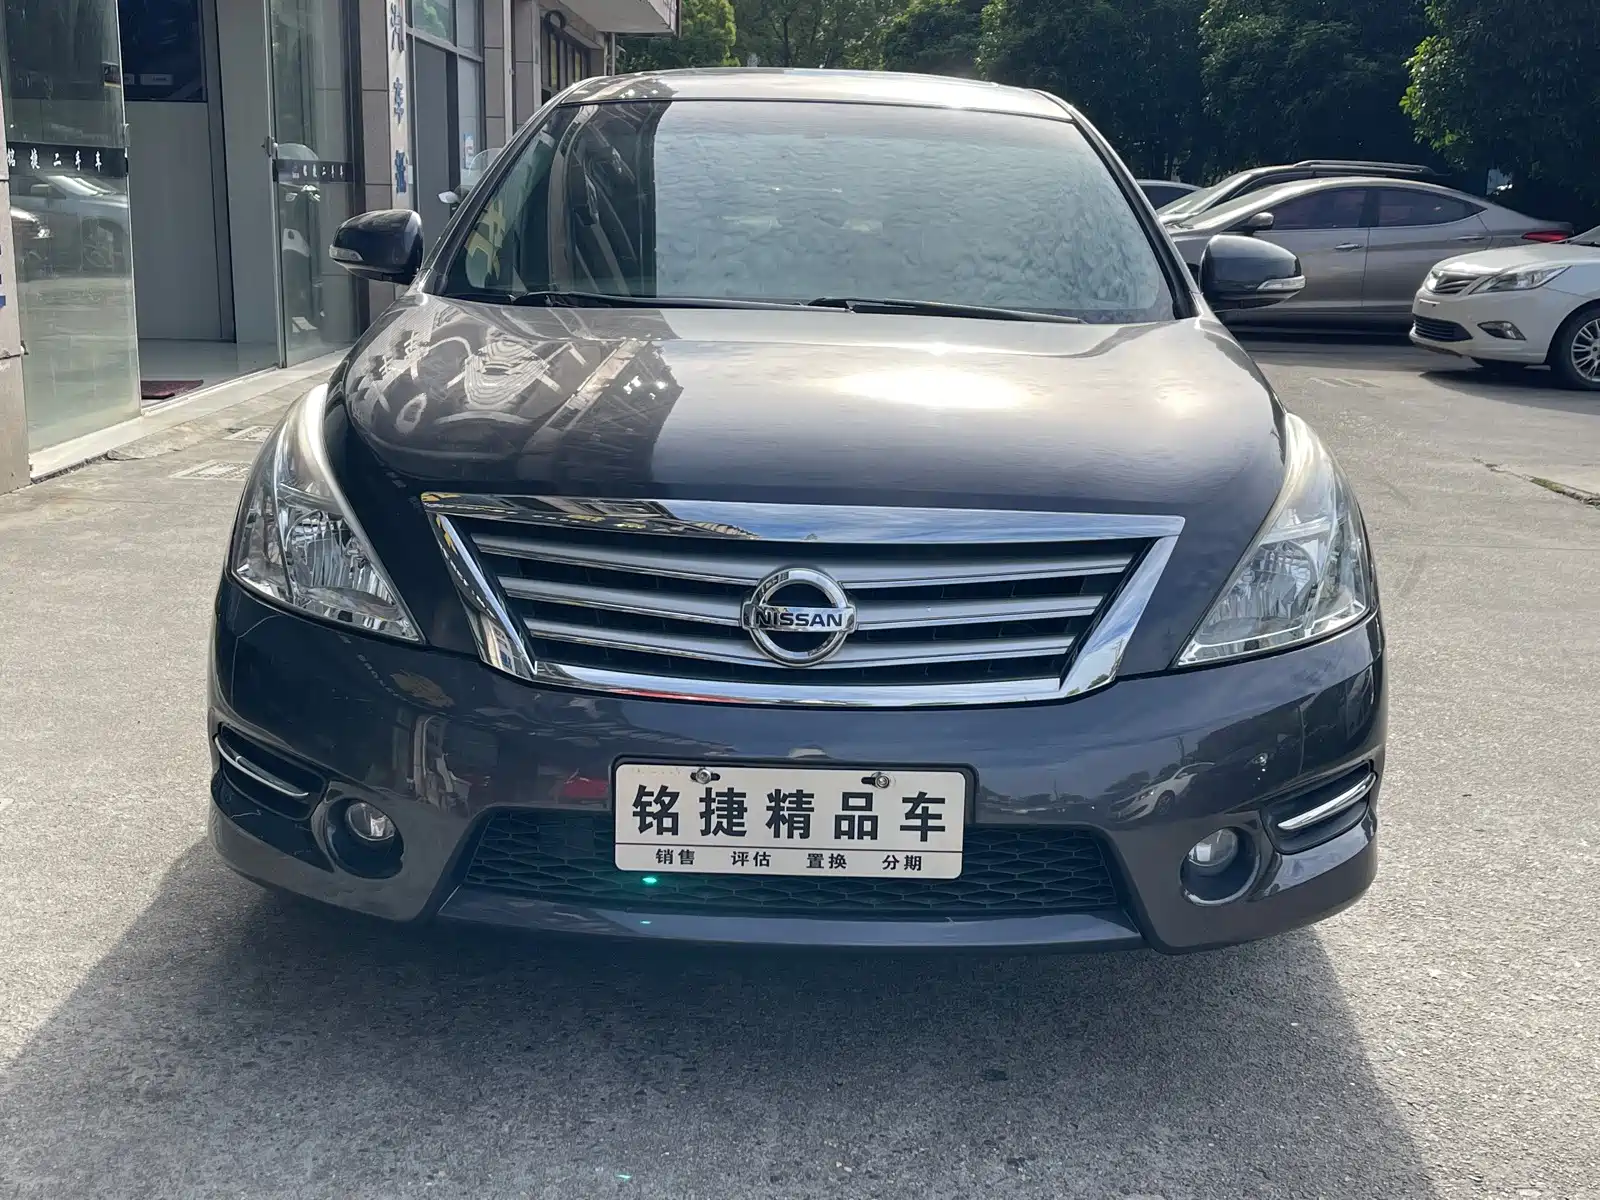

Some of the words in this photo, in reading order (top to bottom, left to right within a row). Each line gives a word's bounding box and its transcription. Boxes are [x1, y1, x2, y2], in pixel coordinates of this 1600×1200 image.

[754, 610, 843, 628] NISSAN
[632, 784, 947, 843] 铭捷精品车
[655, 848, 696, 866] 销售
[730, 850, 772, 868] 评估
[806, 852, 848, 870] 置换
[881, 854, 923, 872] 分期
